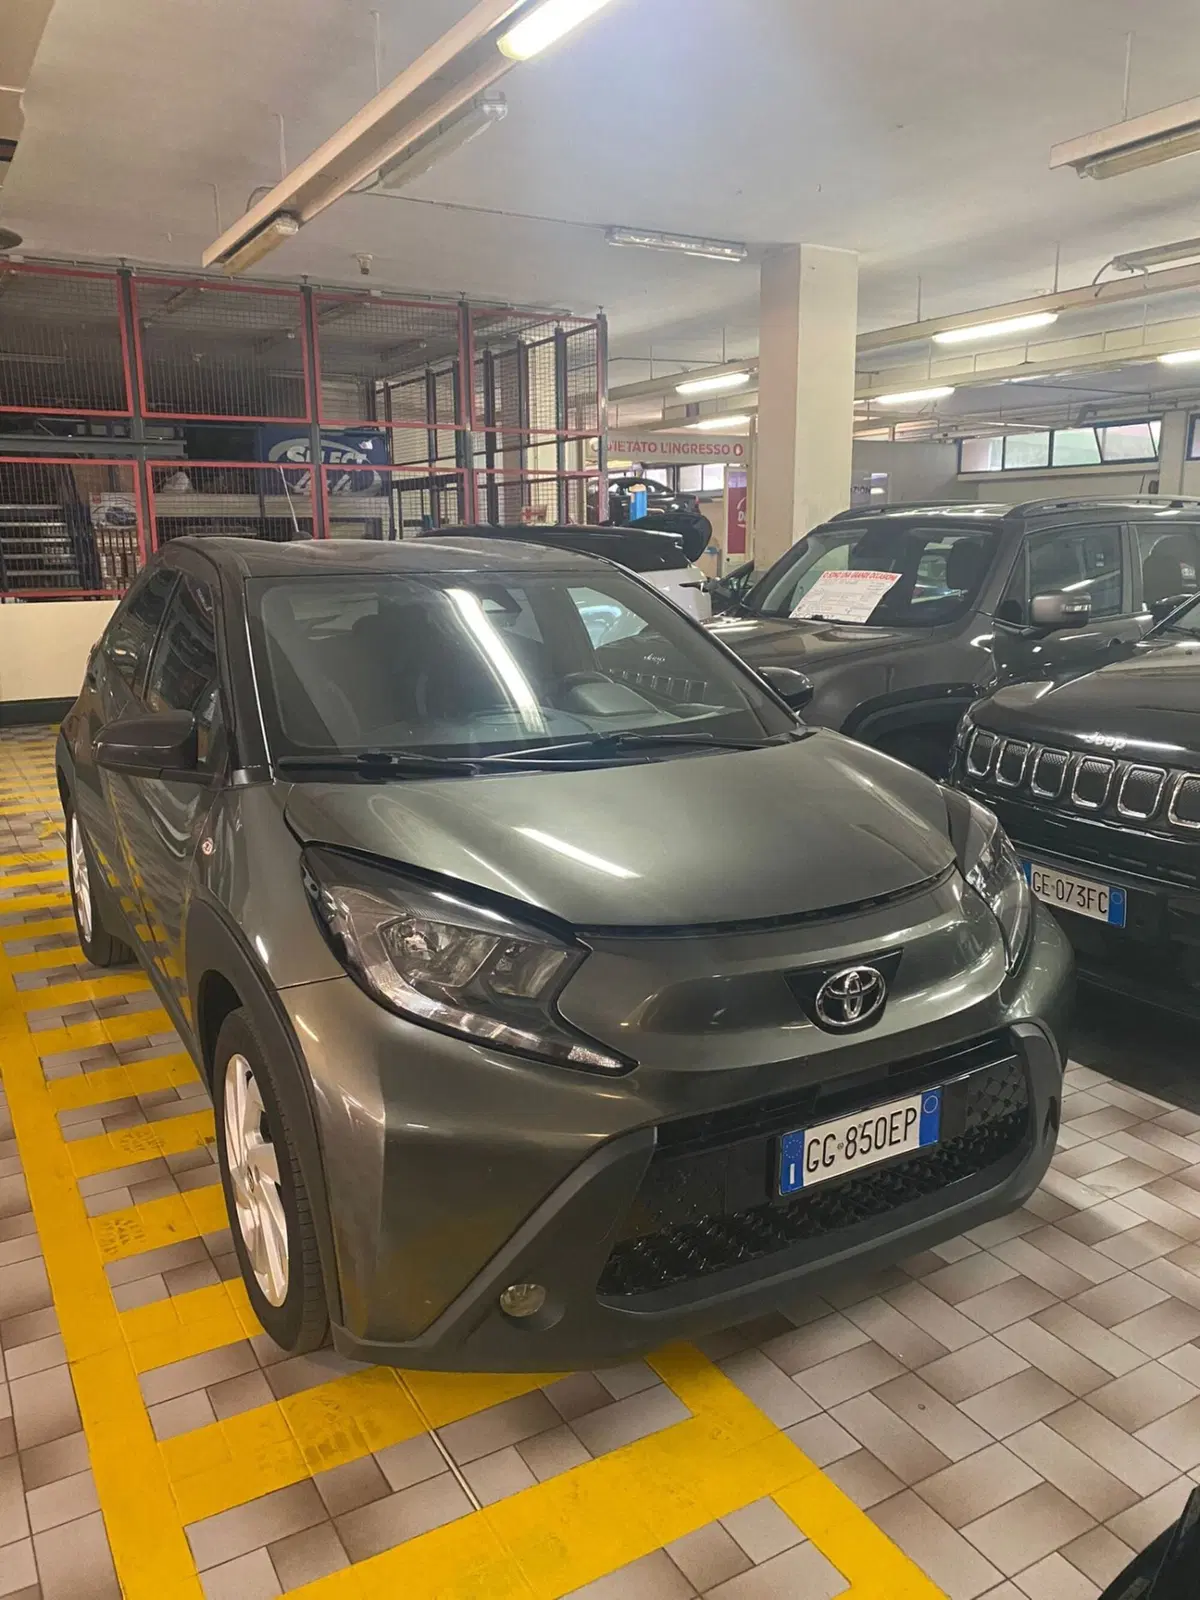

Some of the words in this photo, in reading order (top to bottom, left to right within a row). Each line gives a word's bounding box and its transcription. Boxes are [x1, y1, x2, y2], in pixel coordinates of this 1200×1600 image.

[661, 442, 730, 456] L'INGRESSO
[1083, 731, 1128, 751] Jeep
[1056, 878, 1108, 914] 073FC
[806, 1133, 837, 1173] GG
[844, 1107, 918, 1161] 850EP
